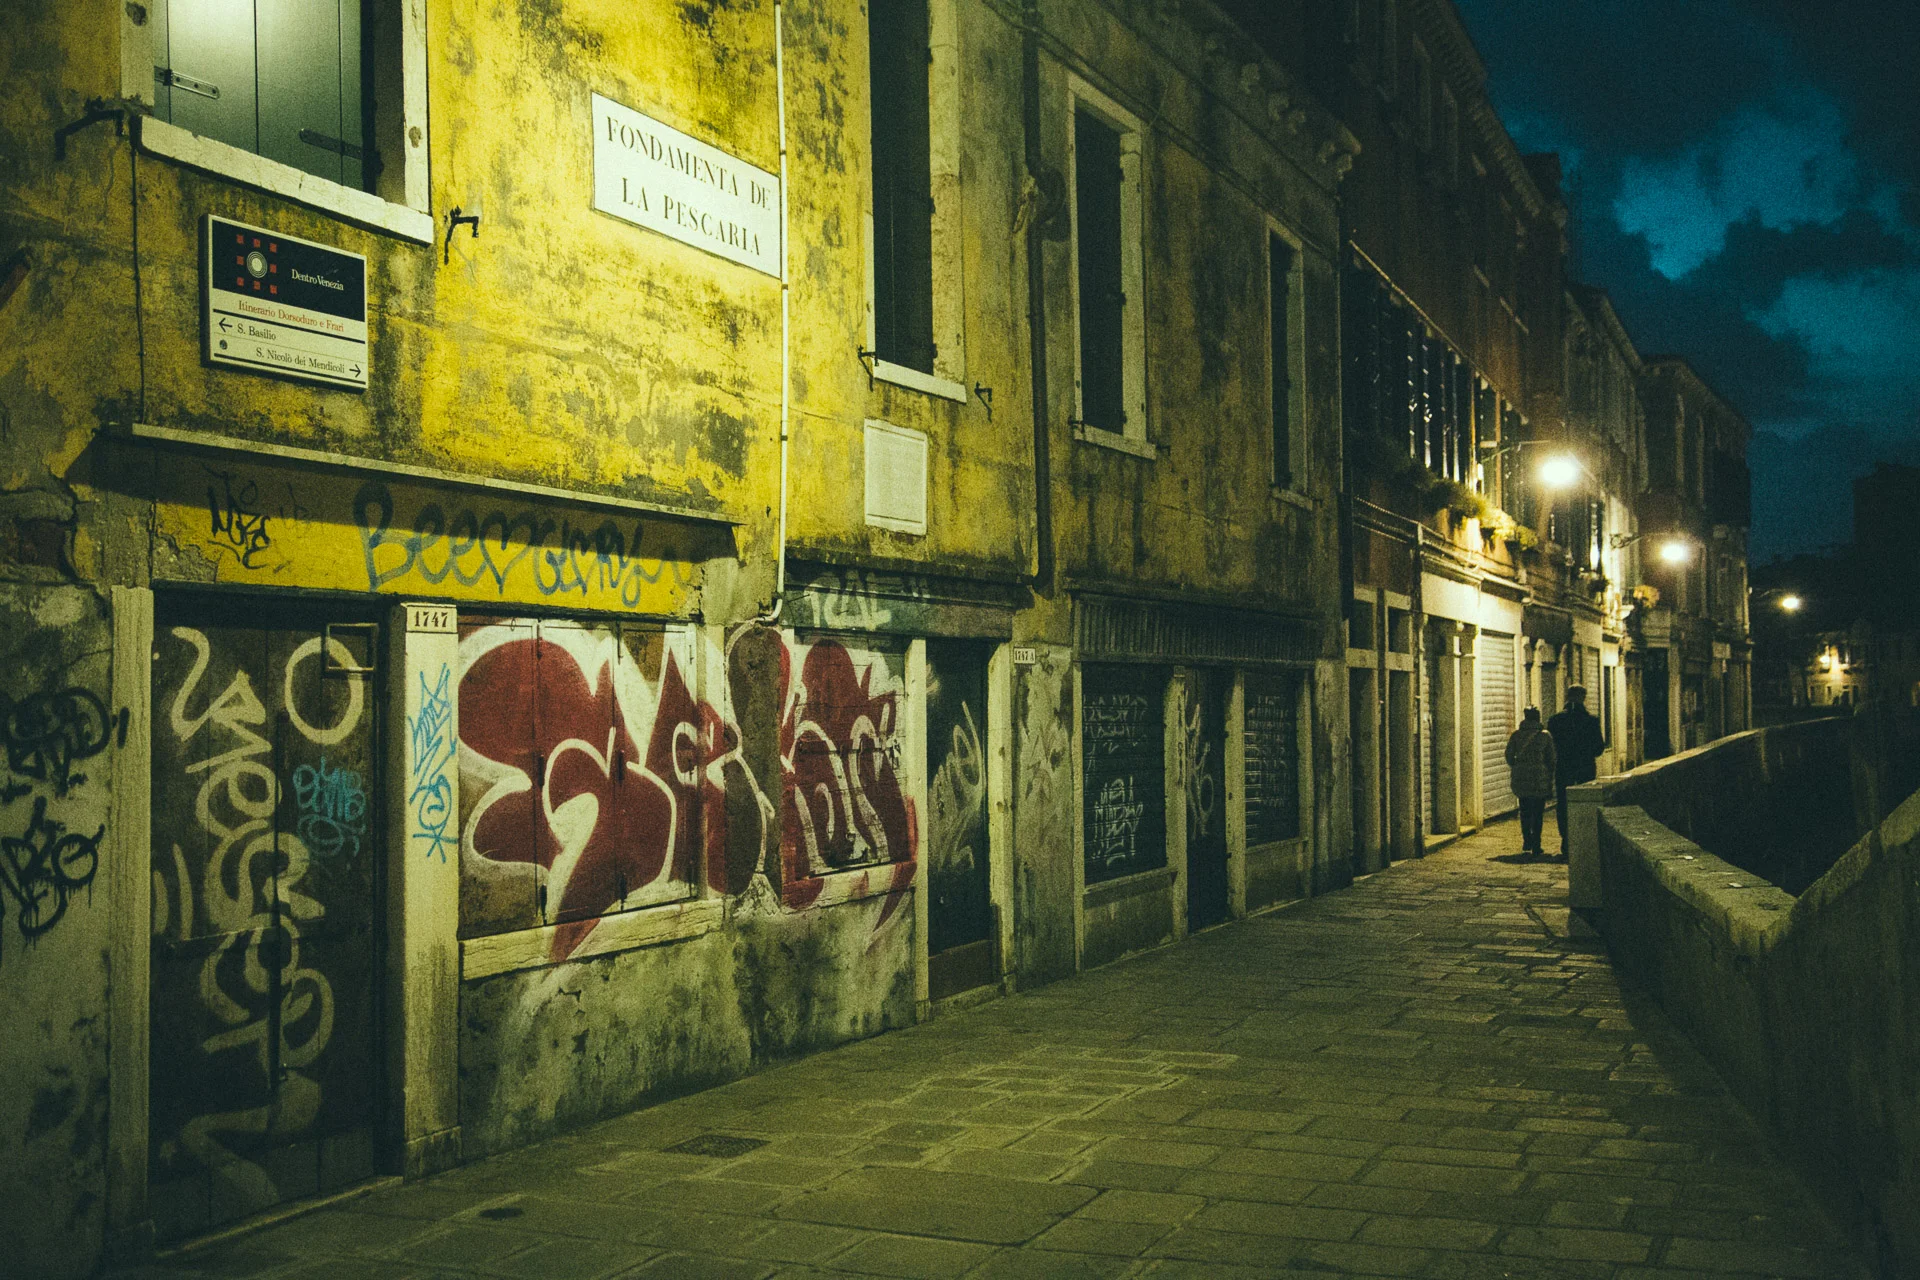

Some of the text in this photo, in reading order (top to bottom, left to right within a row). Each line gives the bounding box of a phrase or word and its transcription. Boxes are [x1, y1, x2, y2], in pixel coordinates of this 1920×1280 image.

[607, 115, 771, 211] FONDAMENTA DE
[622, 177, 760, 256] LA PESCARIA
[238, 300, 276, 317] Itinerario
[278, 310, 318, 326] Dorsoduro
[326, 319, 344, 333] Frari
[237, 323, 277, 341] S. Basilio
[255, 348, 345, 374] S. Nicolò dei Mendicoli
[414, 610, 448, 628] 1747
